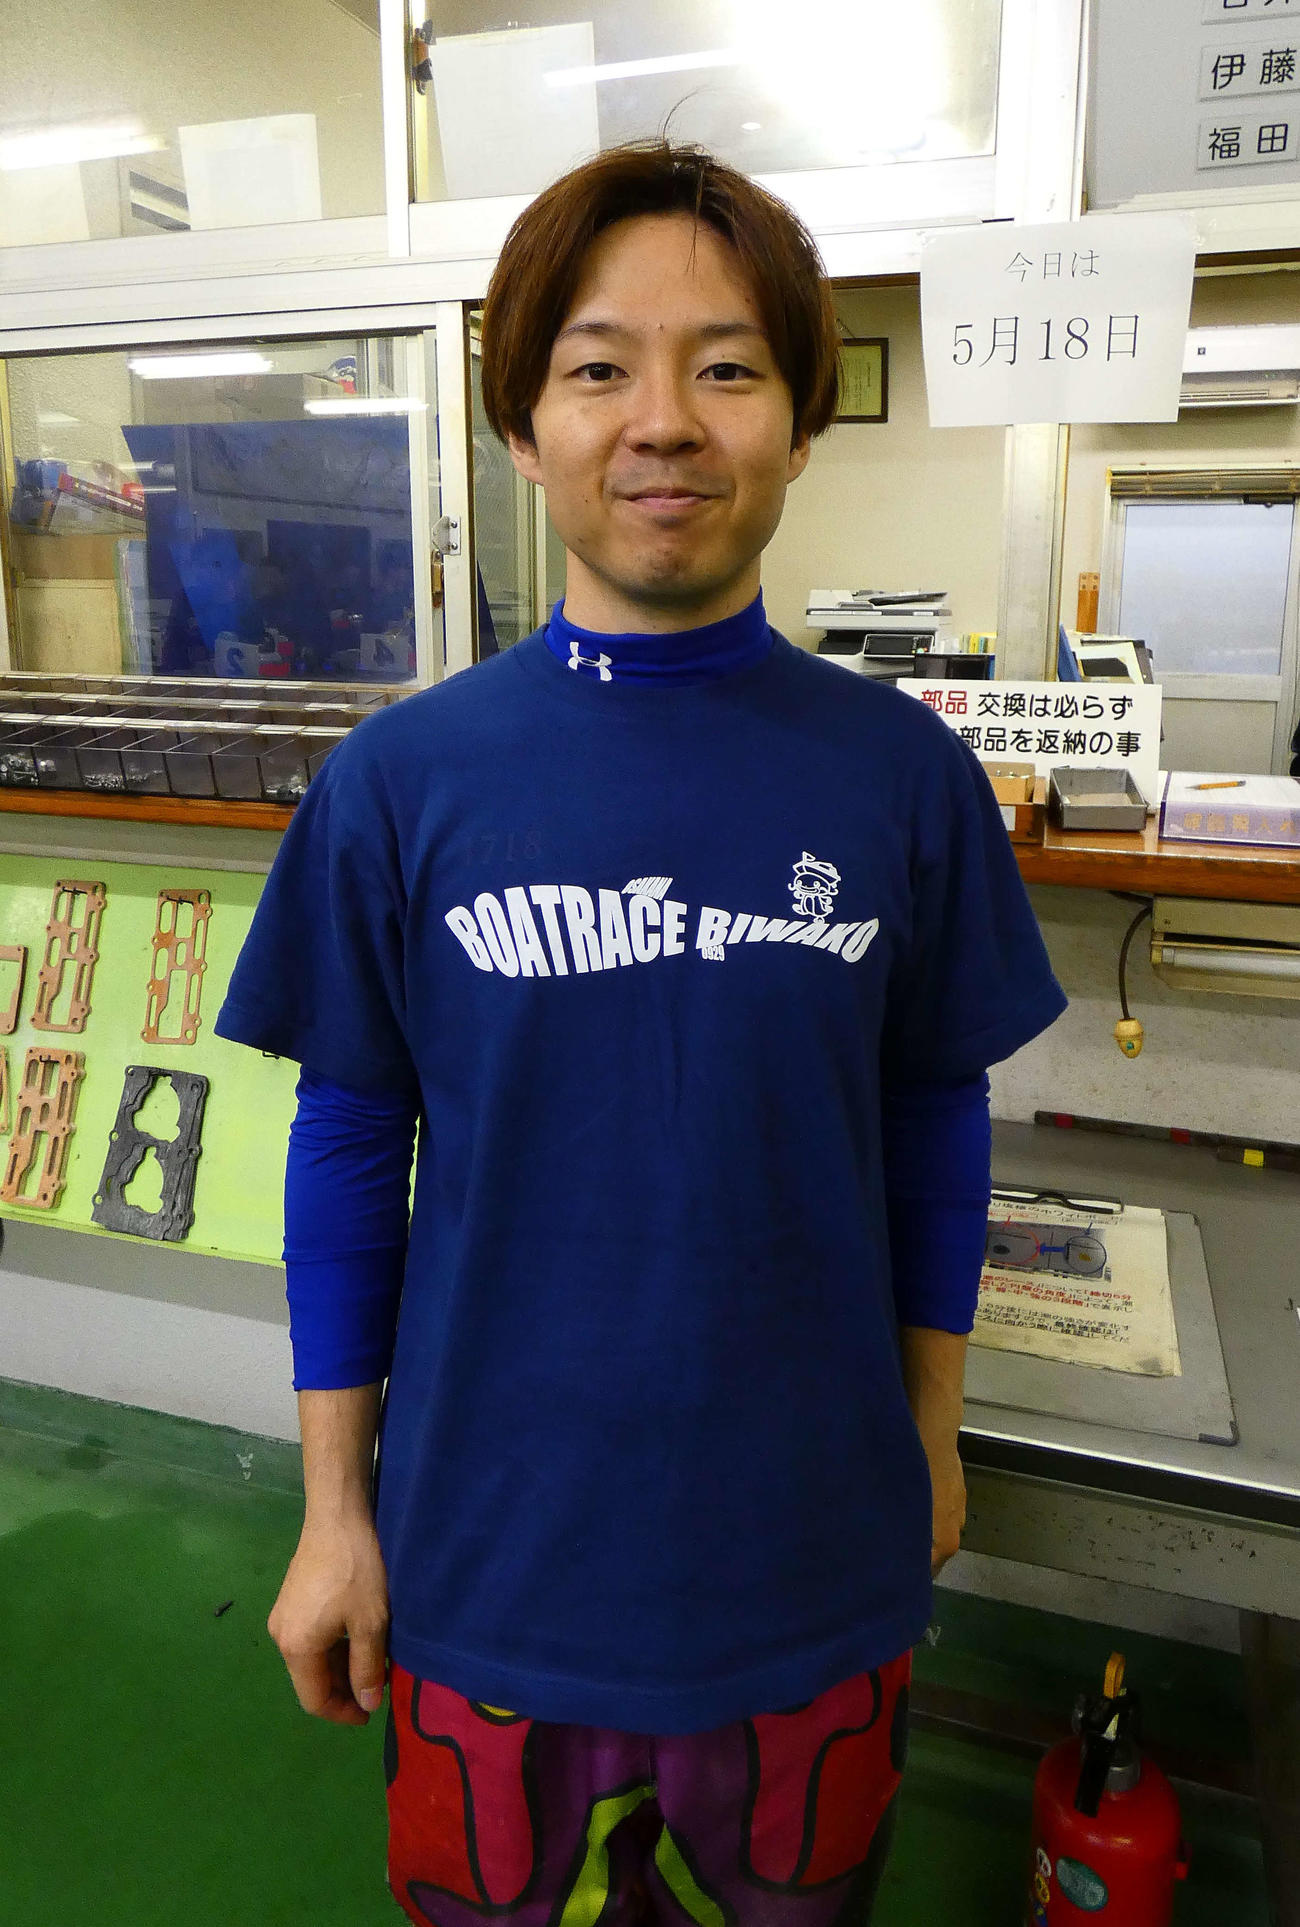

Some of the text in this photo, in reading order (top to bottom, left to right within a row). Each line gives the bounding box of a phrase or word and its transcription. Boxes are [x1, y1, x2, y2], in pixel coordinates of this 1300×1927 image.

[1211, 48, 1297, 90] 伊藤
[1208, 123, 1288, 160] 福田
[1004, 250, 1099, 282] 今日は
[953, 315, 1139, 367] 5月18日
[921, 689, 1133, 720] 部品 交換は必らず
[951, 725, 1142, 757] 部品を返納の事
[444, 885, 879, 978] BOATRACE BIWAKO
